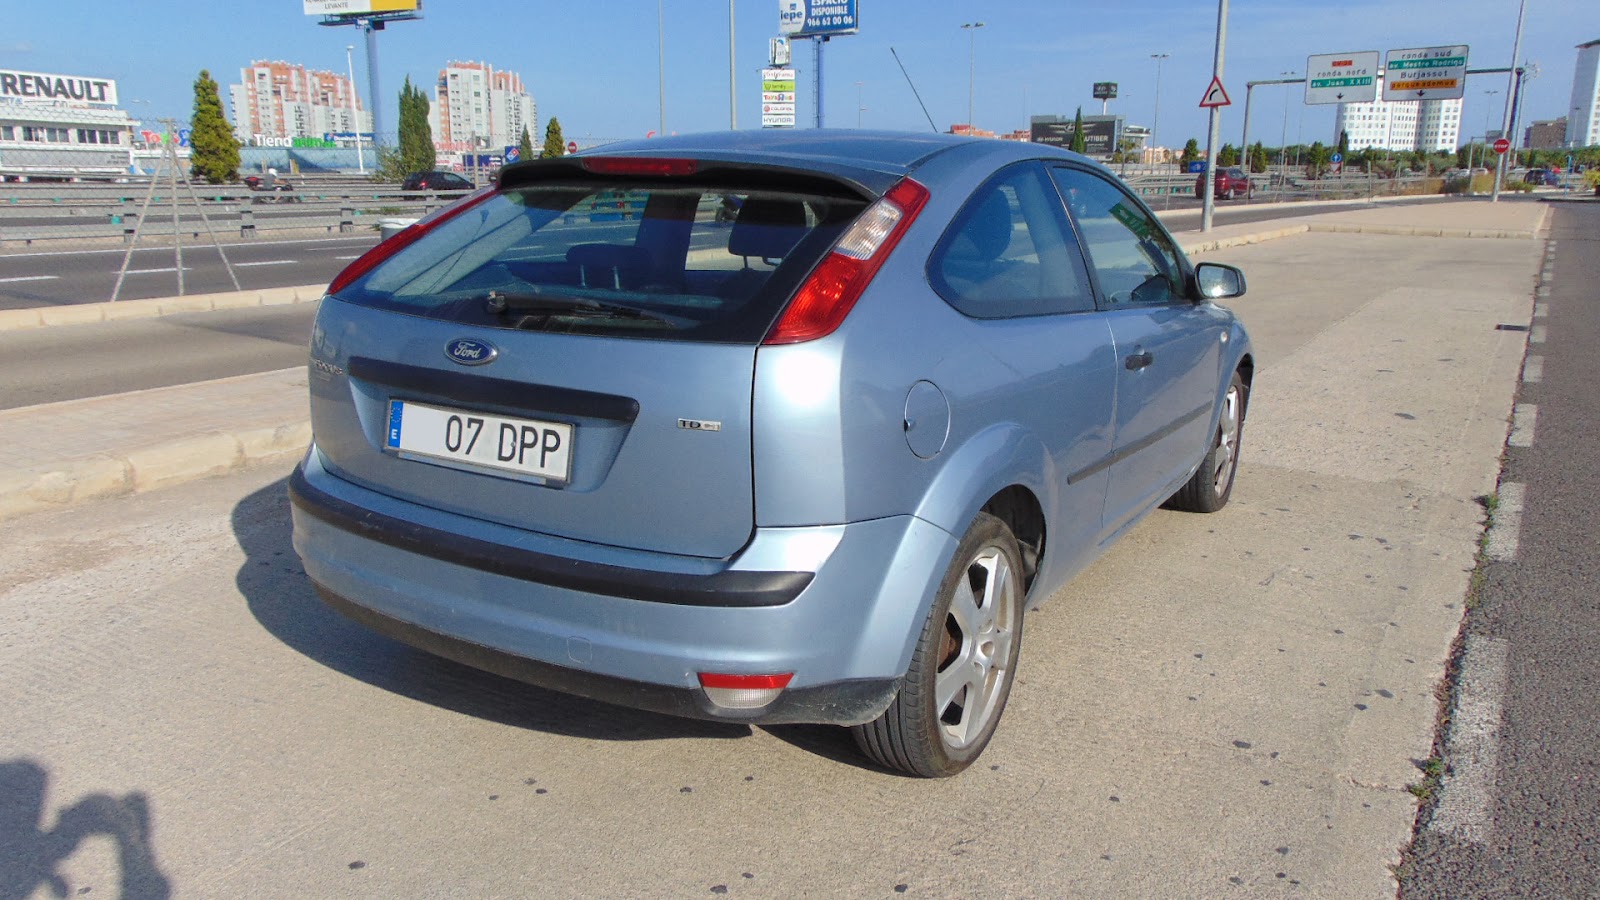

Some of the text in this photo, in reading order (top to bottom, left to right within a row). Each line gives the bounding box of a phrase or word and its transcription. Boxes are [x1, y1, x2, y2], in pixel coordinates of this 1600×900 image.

[780, 10, 802, 21] iepe
[812, 6, 848, 16] DISPONIBLE
[808, 16, 853, 26] 966 62 00 06
[1400, 70, 1448, 79] Burjassot
[0, 72, 108, 102] RENAULT
[454, 342, 481, 359] Ford
[392, 415, 561, 468] E 07 DPP
